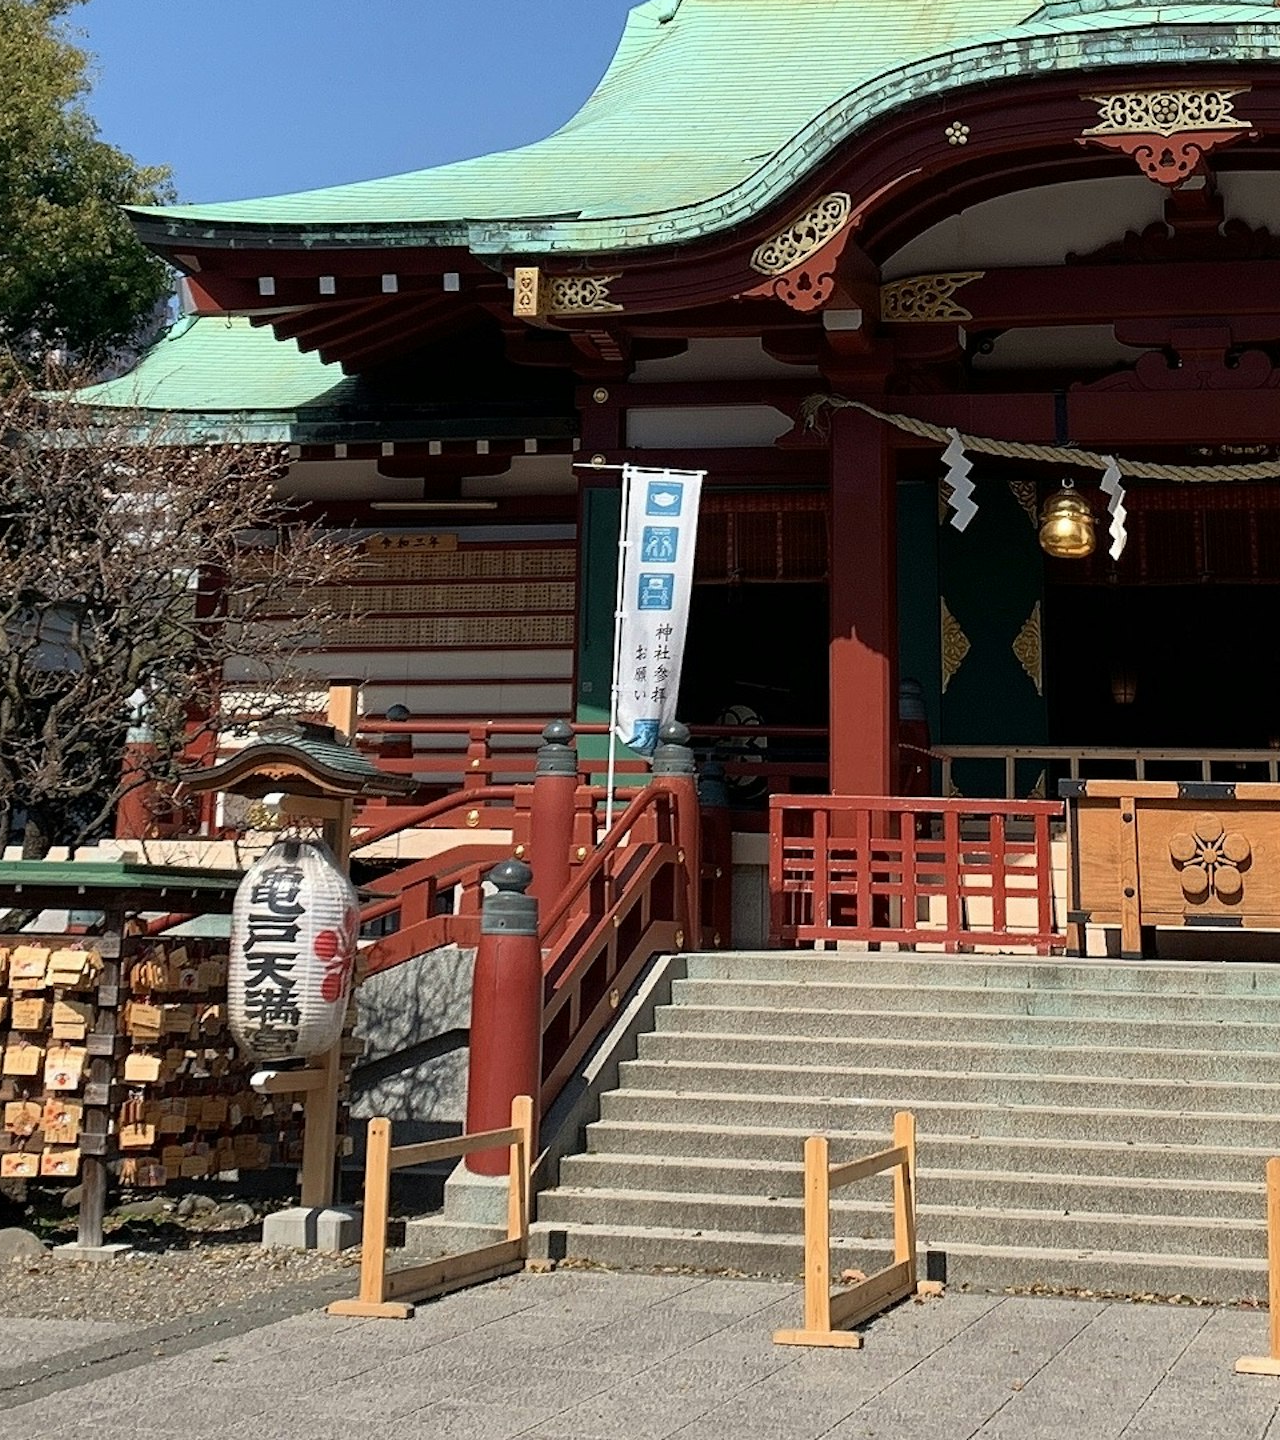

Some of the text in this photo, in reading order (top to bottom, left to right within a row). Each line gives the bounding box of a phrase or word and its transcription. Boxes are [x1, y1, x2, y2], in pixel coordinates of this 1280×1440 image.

[634, 643, 648, 701] お願い
[650, 622, 674, 706] 神社参拝
[243, 864, 306, 1054] 亀戸天満宮
